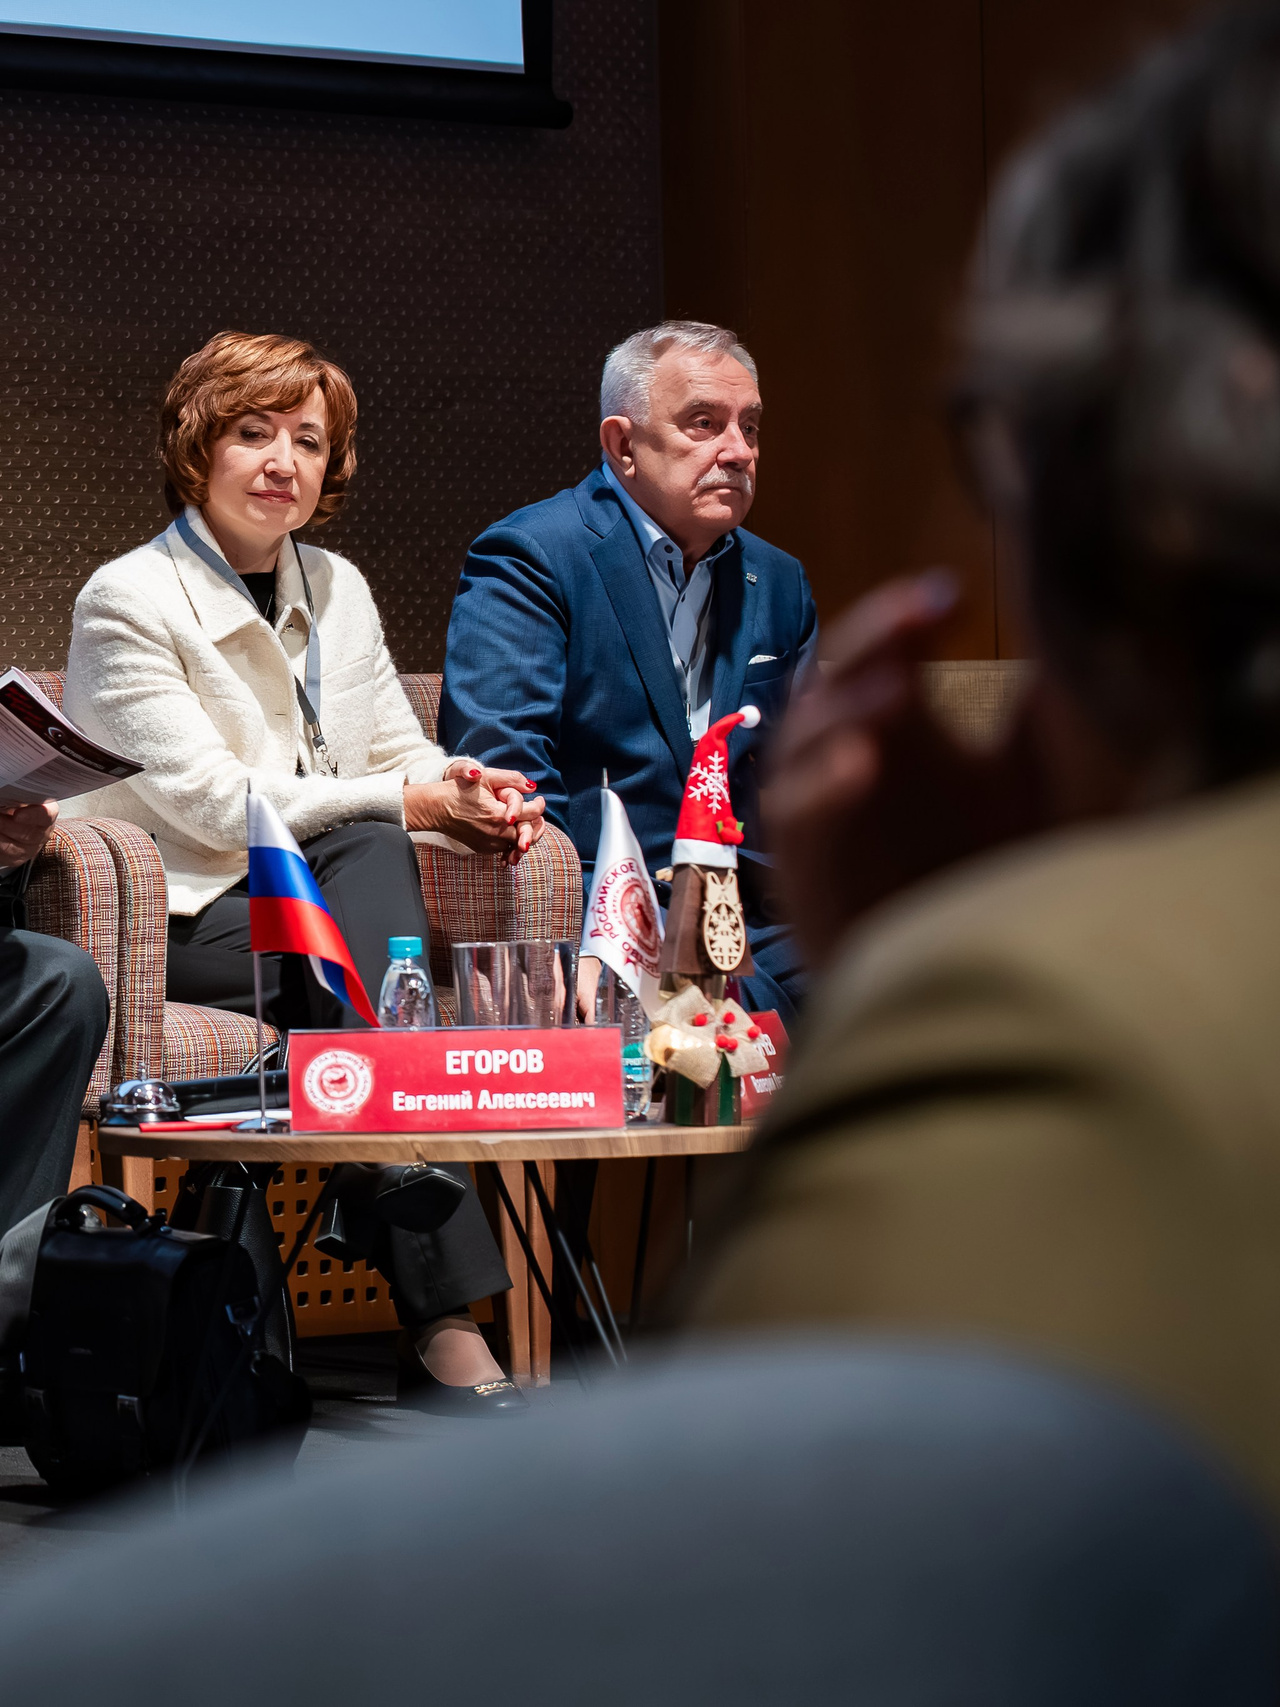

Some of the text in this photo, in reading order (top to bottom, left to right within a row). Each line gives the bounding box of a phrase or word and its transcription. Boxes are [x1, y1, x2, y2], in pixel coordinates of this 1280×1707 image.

[445, 1048, 545, 1075] ЕГОРОВ
[392, 1089, 596, 1112] Евгений Алексеевич
